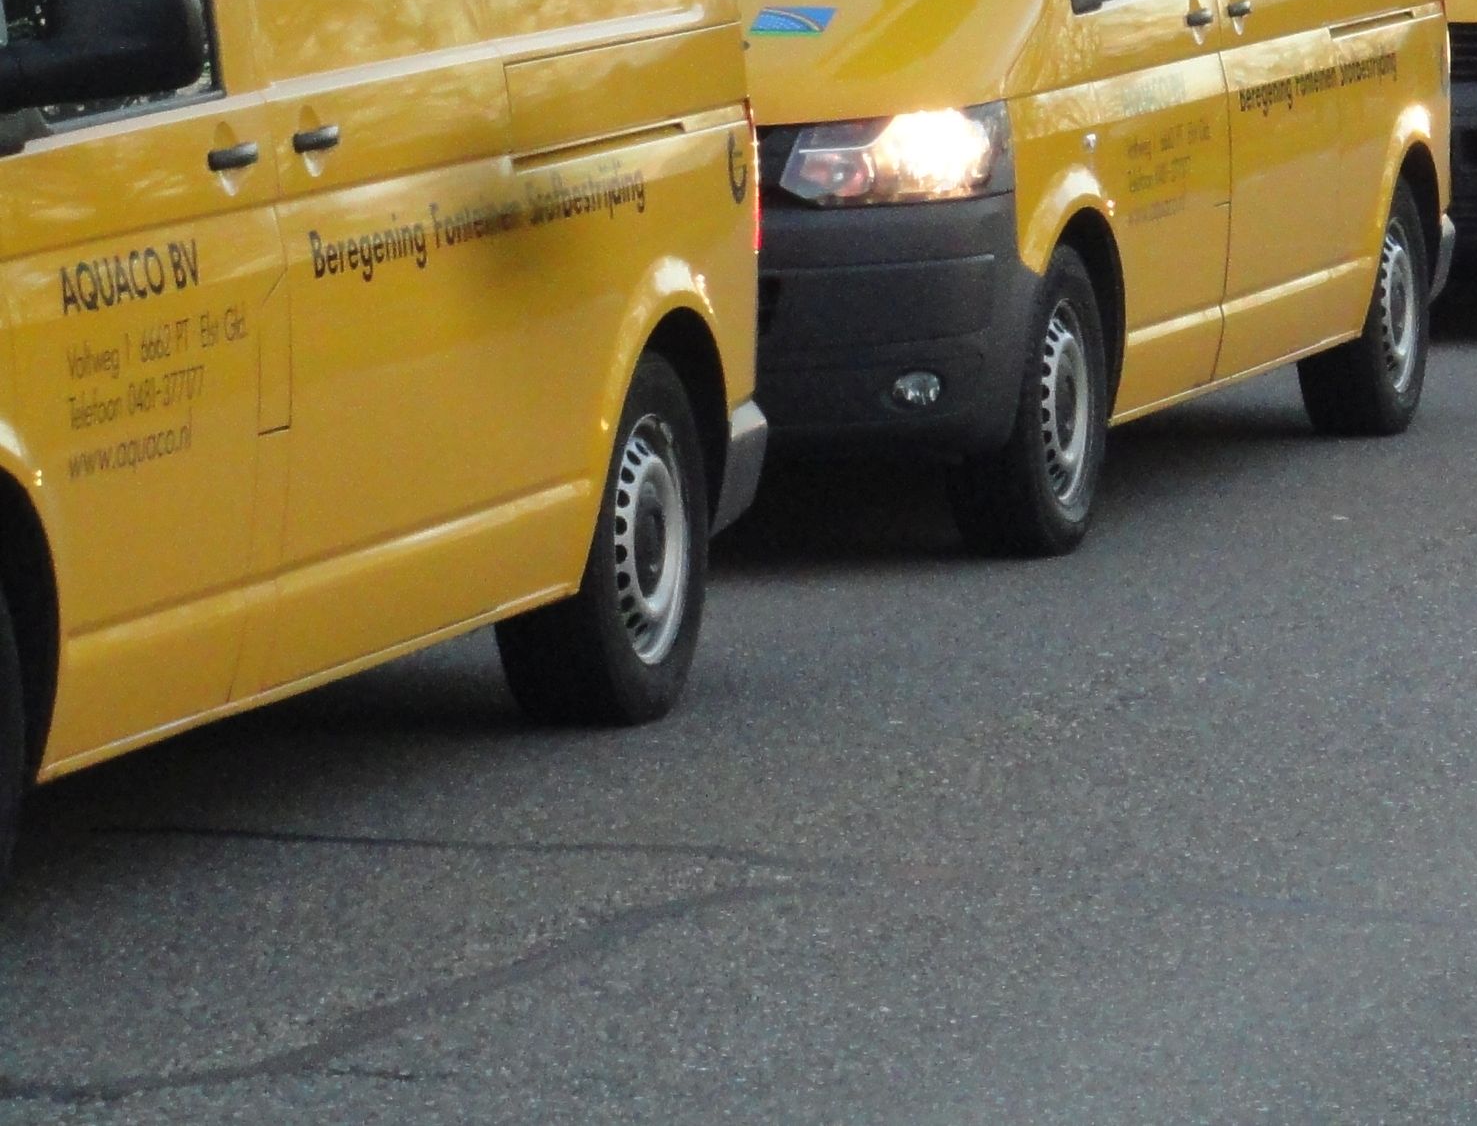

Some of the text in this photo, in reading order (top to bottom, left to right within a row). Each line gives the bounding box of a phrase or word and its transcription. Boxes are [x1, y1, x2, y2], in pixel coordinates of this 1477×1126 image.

[60, 237, 199, 316] AQUACO BV
[309, 210, 428, 283] Beregening
[67, 405, 195, 481] www.aquaco.nl
